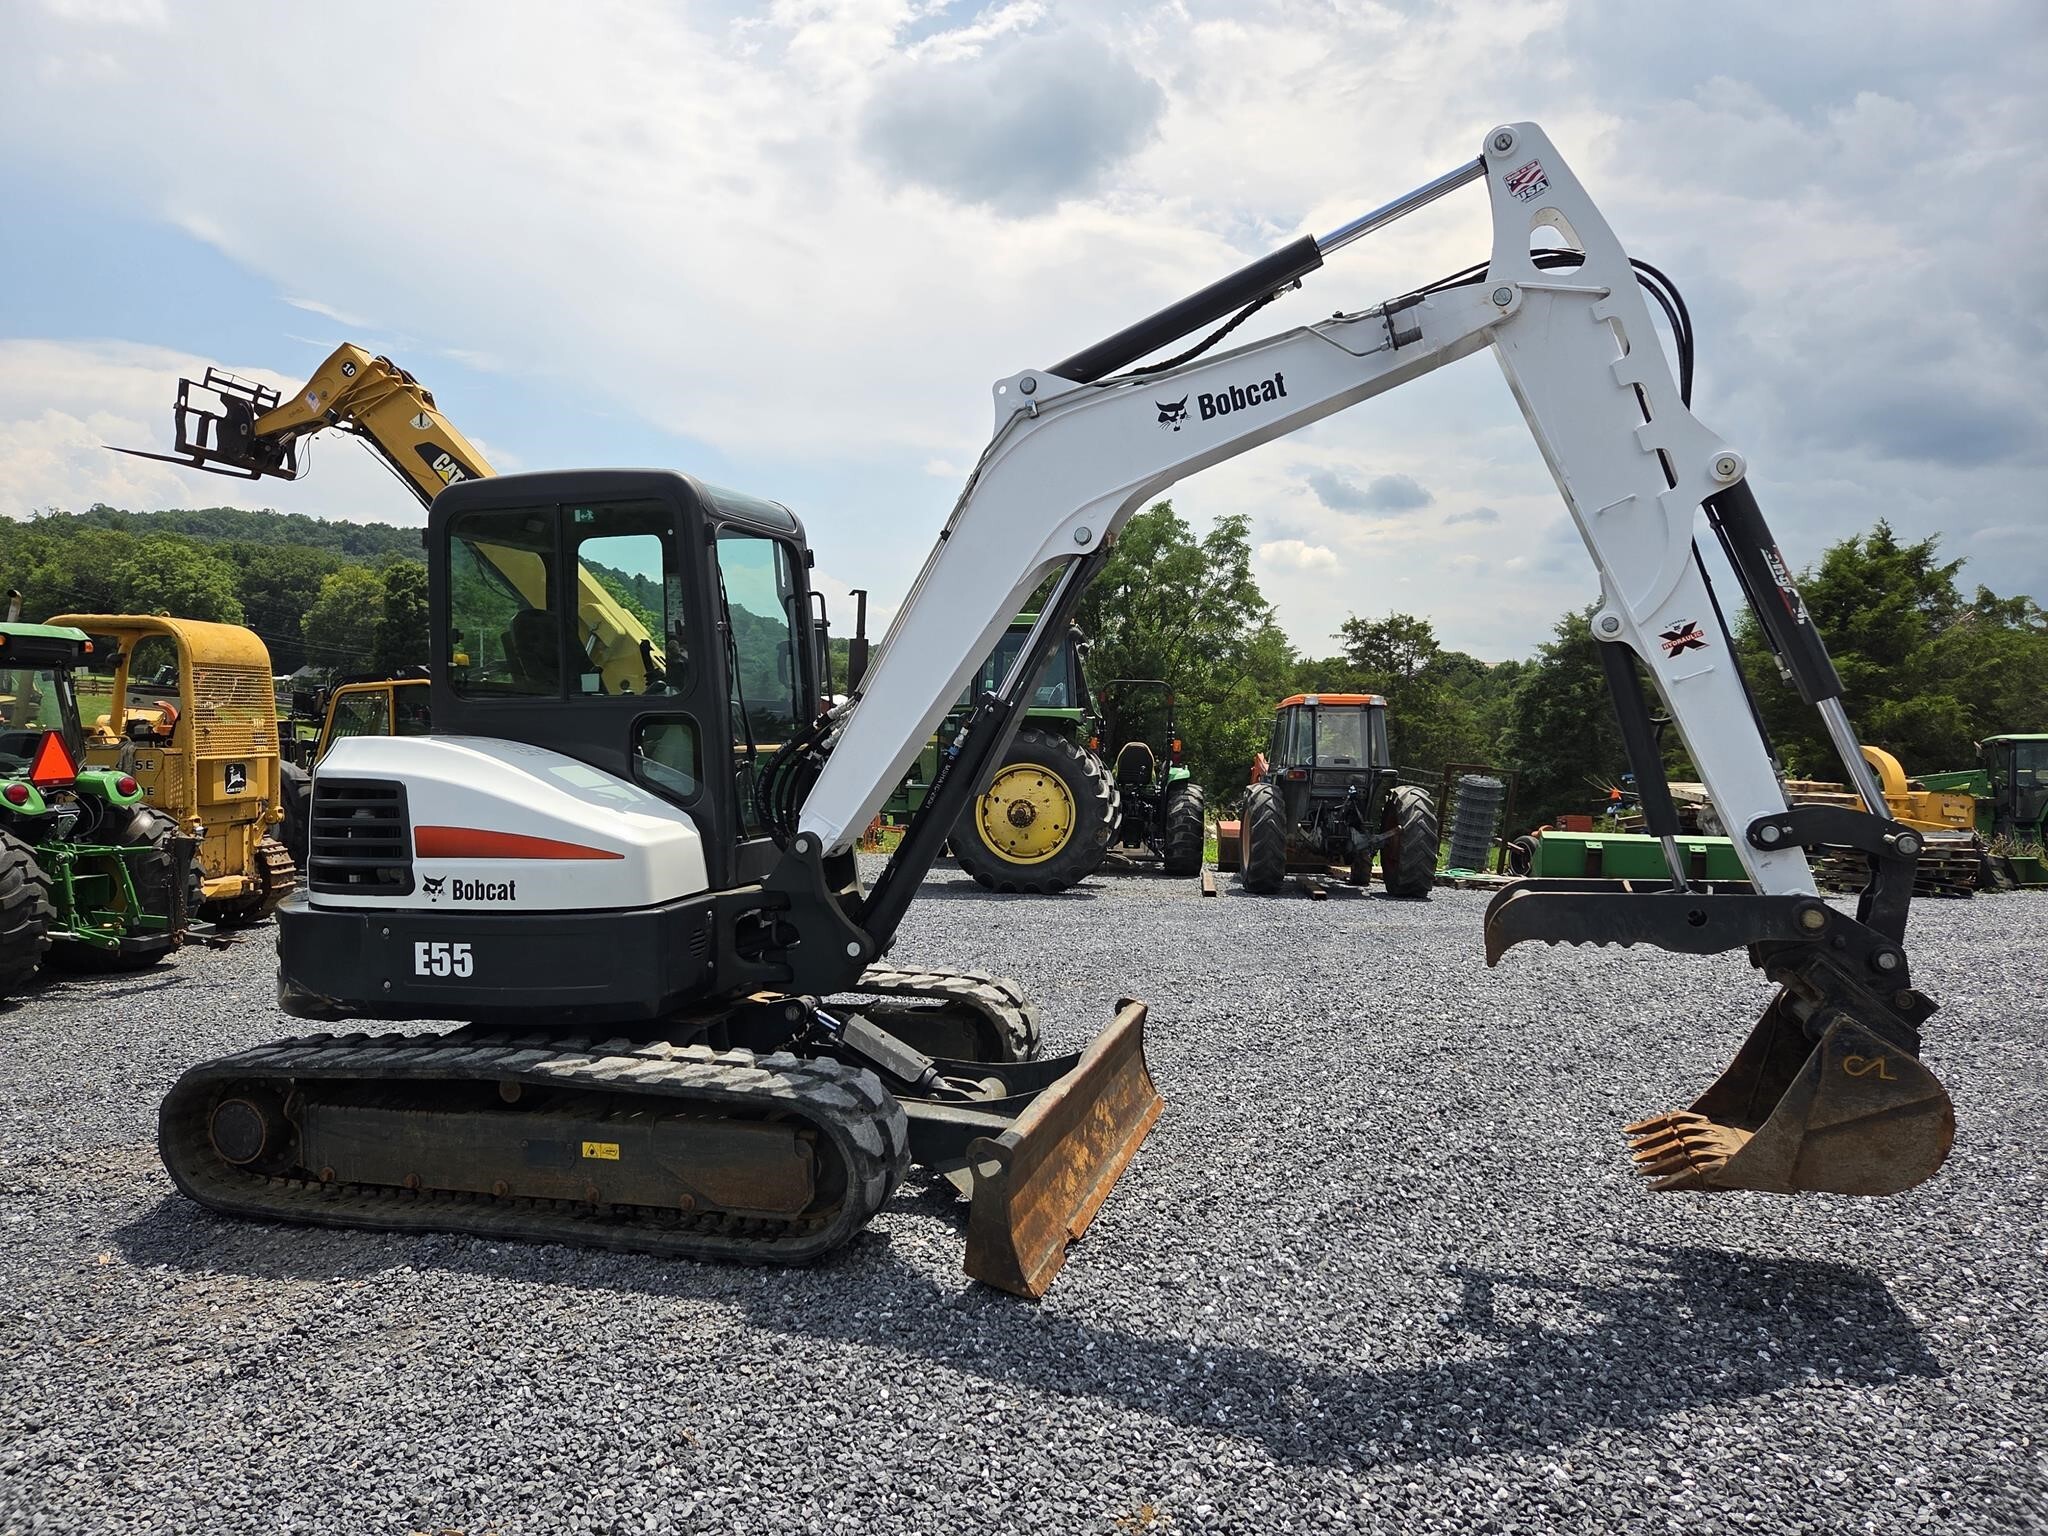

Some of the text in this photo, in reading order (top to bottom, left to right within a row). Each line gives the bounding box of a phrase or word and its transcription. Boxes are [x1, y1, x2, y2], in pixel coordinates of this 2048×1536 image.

[343, 363, 355, 376] 10
[1198, 372, 1287, 421] Bobcat
[432, 453, 465, 486] CAT
[1662, 630, 1704, 650] HYDRAULIC
[452, 879, 516, 901] Bobcat
[414, 941, 474, 978] E55
